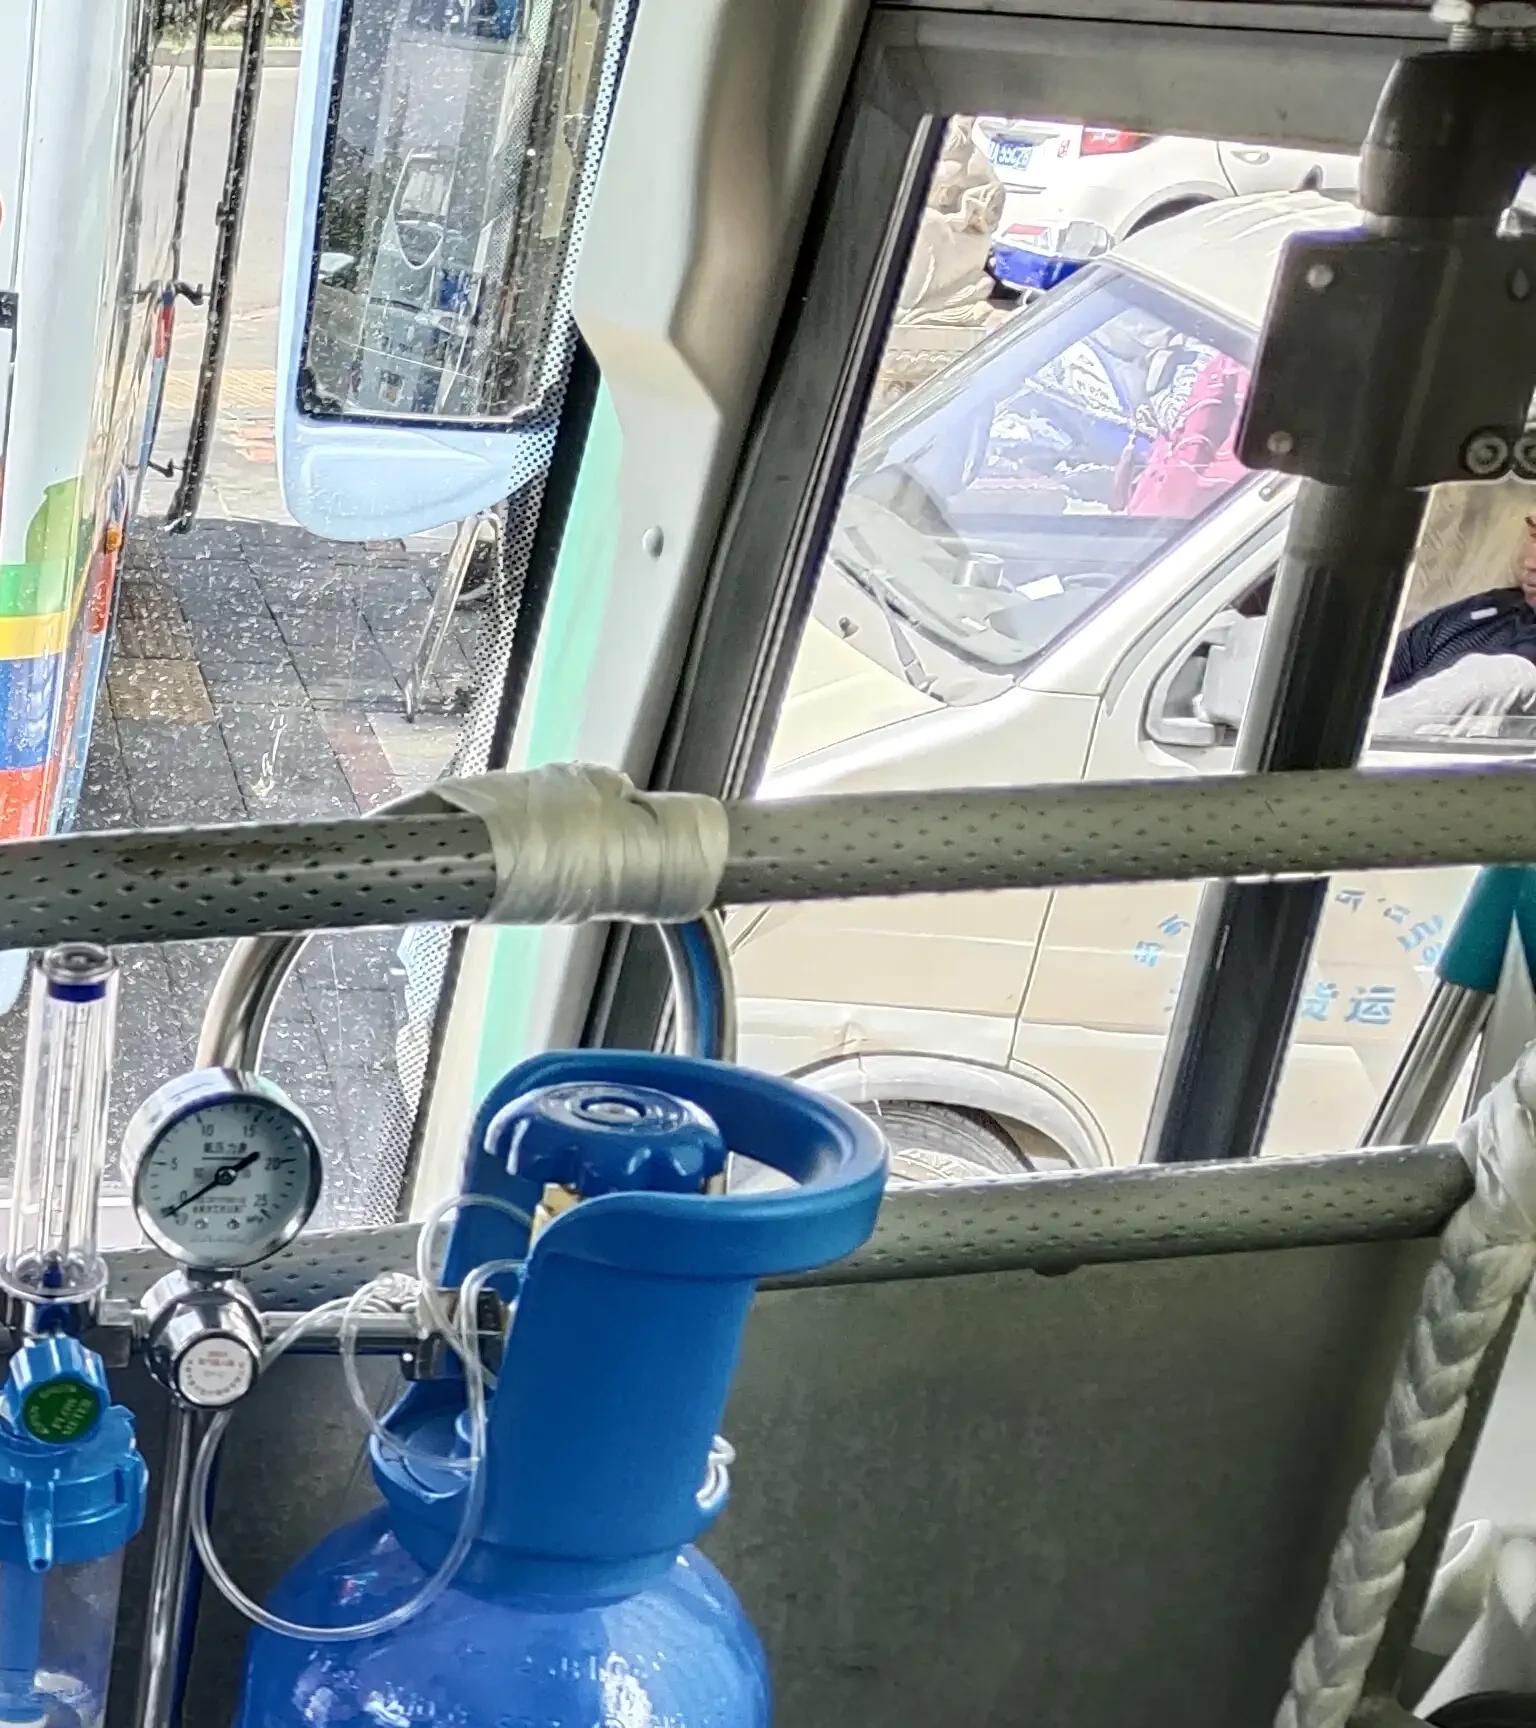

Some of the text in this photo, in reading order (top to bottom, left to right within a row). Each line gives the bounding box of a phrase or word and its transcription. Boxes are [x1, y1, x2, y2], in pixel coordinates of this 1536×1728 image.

[201, 1124, 214, 1137] 10
[242, 1124, 256, 1137] 15
[170, 1158, 178, 1170] 5
[265, 1157, 281, 1171] 20
